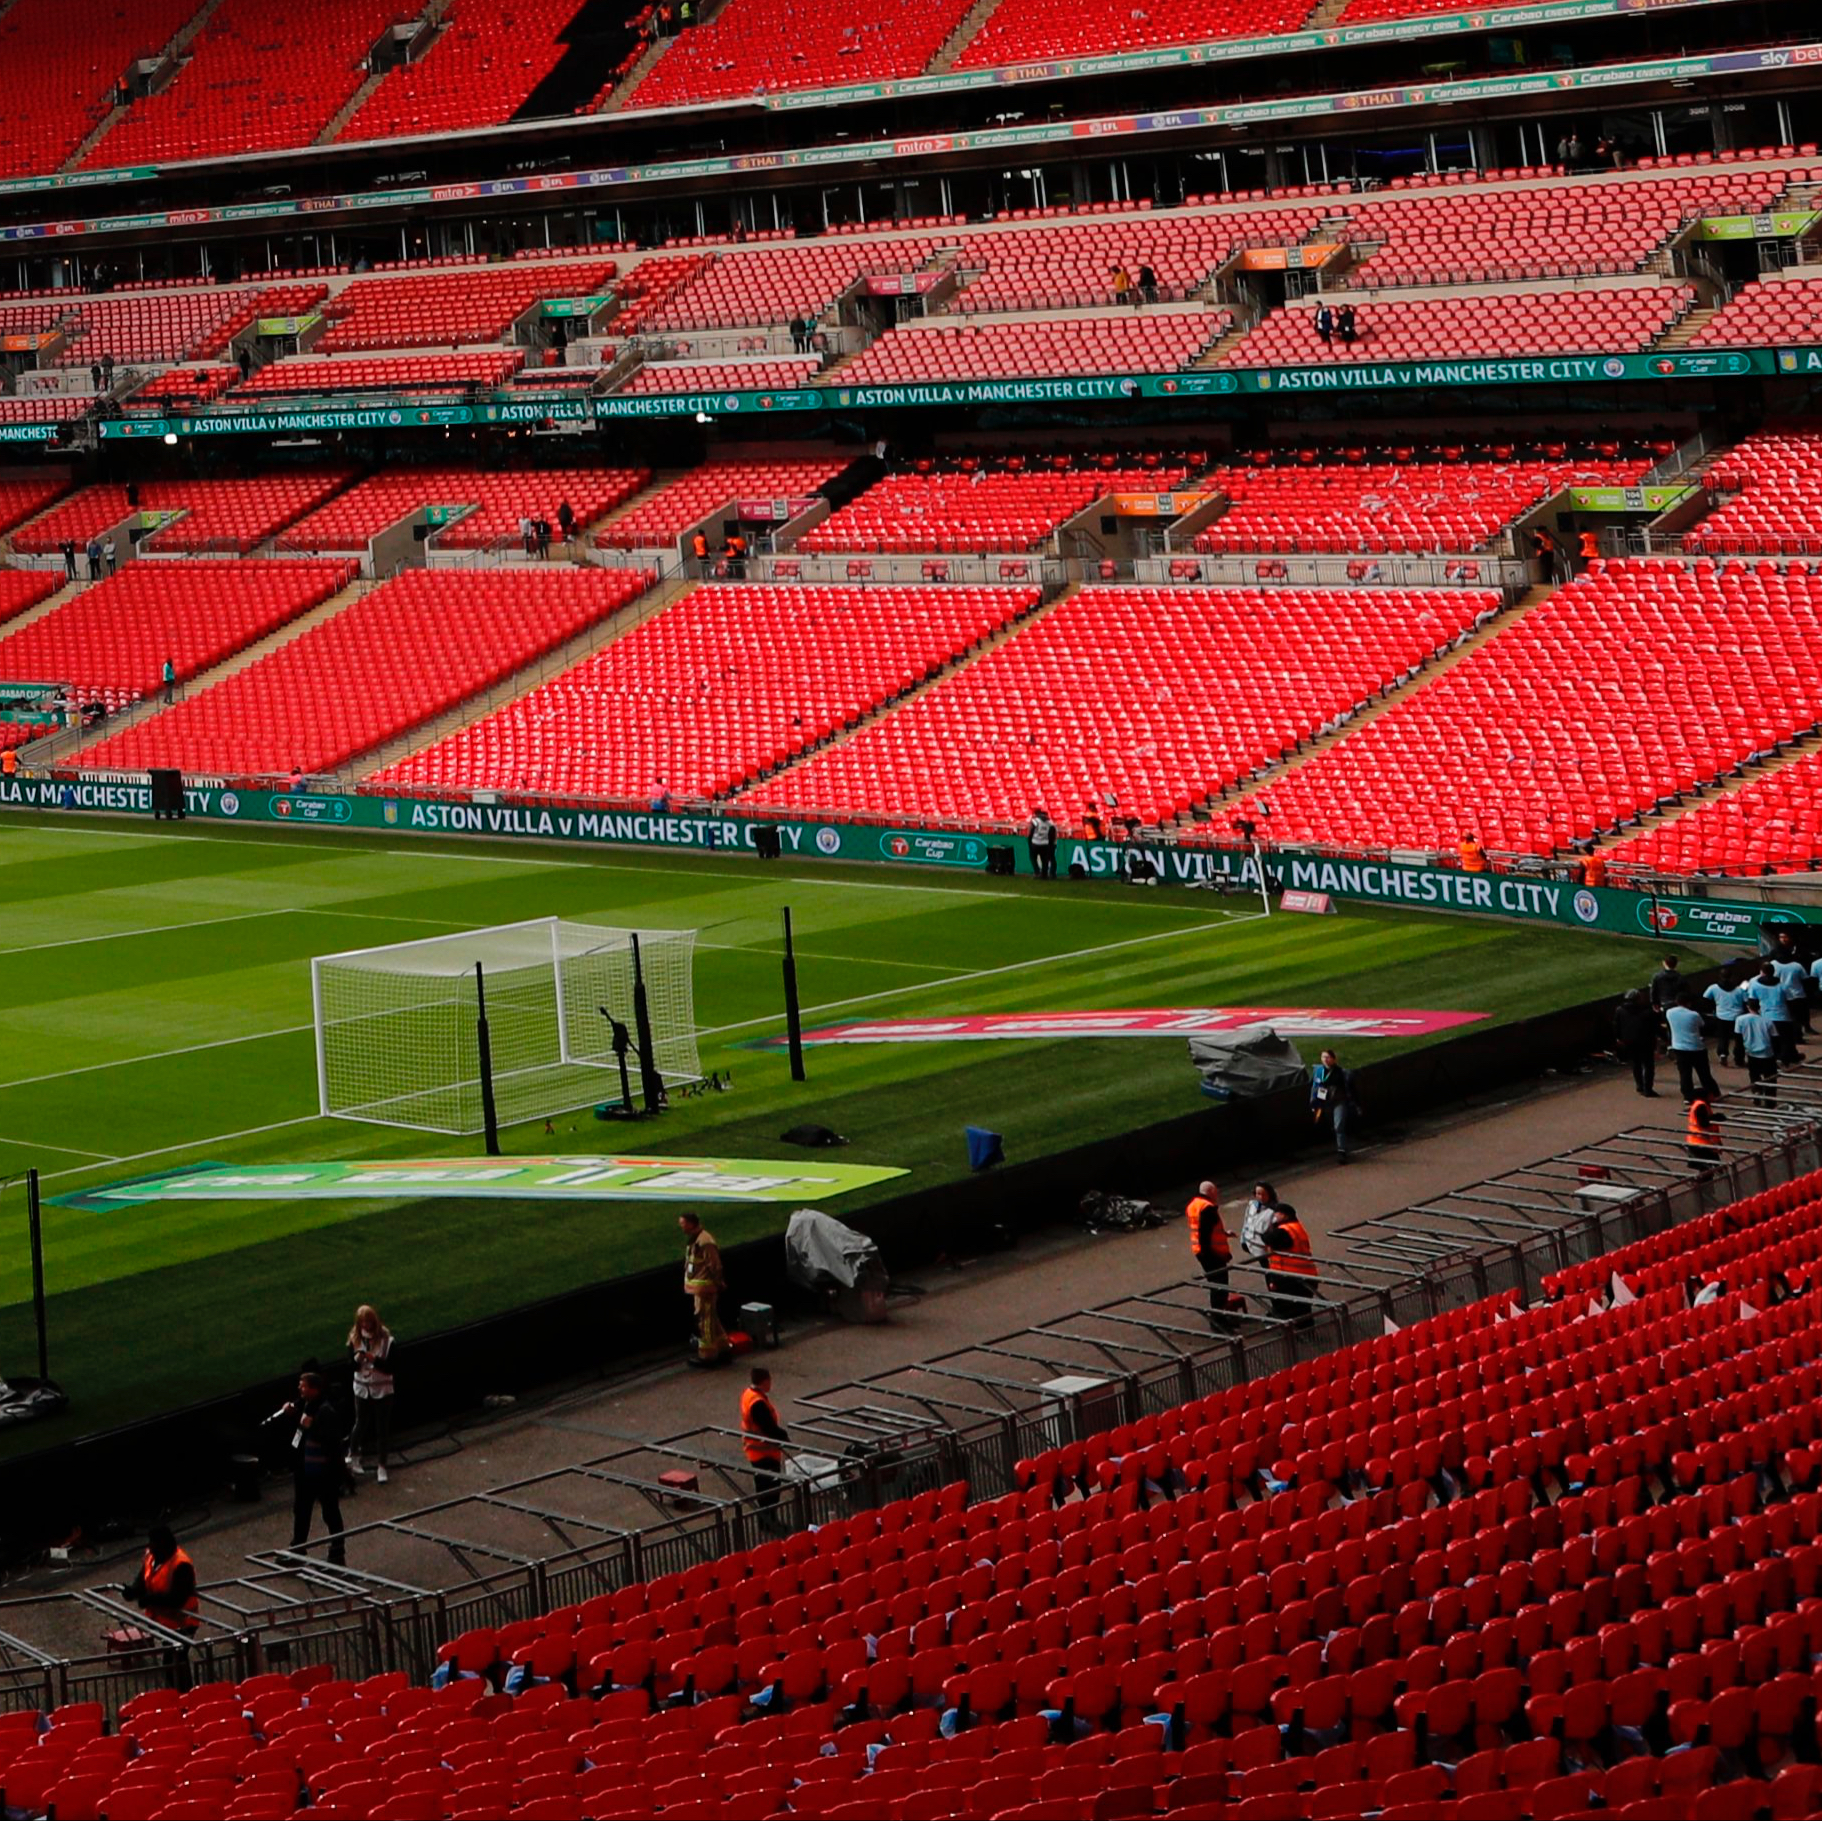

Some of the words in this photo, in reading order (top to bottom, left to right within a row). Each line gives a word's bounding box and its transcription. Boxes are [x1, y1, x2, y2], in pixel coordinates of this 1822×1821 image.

[1491, 9, 1543, 24] Carabao
[1545, 6, 1583, 19] ENERGY
[1585, 2, 1614, 14] DRINK
[1346, 27, 1393, 41] Carabao
[1760, 50, 1789, 66] sky
[1792, 46, 1822, 61] bet
[1018, 67, 1048, 78] THAI
[1581, 70, 1634, 85] Carabao
[1636, 66, 1675, 79] ENERGY
[1677, 63, 1706, 76] DRINK
[1431, 84, 1480, 99] Carabao
[1482, 81, 1518, 94] ENERGY
[1520, 79, 1548, 91] DRINK
[1361, 93, 1394, 106] THAI
[1103, 122, 1118, 131] EFL
[1166, 115, 1182, 125] EFL
[897, 141, 932, 154] mitre
[1679, 358, 1718, 367] Carabao
[1690, 365, 1709, 374] Cup
[1279, 371, 1337, 387] ASTON
[1341, 369, 1395, 385] VILLA
[1400, 372, 1410, 382] v
[1416, 363, 1543, 382] MANCHESTER
[1551, 362, 1595, 377] CITY
[857, 390, 904, 403] ASTON
[908, 388, 952, 401] VILLA
[956, 390, 964, 400] v
[969, 383, 1072, 399] MANCHESTER
[1078, 381, 1113, 396] CITY
[502, 406, 543, 418] ASTON
[548, 403, 584, 416] VILLA
[597, 396, 685, 415] MANCHESTER
[688, 397, 721, 411] CITY
[195, 419, 231, 431] ASTON
[233, 418, 266, 429] VILLA
[269, 420, 275, 428] v
[278, 414, 354, 428] MANCHESTER
[358, 413, 385, 424] CITY
[26, 689, 41, 699] CUP
[26, 787, 36, 801] v
[41, 782, 153, 809] MANCHESTE
[296, 800, 326, 810] Carabao
[304, 808, 318, 817] Cup
[411, 804, 482, 830] ASTON
[487, 808, 554, 834] VILLA
[559, 818, 572, 834] v
[578, 813, 738, 847] MANCHESTER
[744, 821, 802, 851] CTY
[915, 838, 954, 850] Carabao
[926, 847, 945, 859] Cup
[1071, 845, 1165, 878] ASTON
[1171, 850, 1261, 884] VILLA
[1291, 860, 1492, 908] MANCHESTER
[1499, 881, 1560, 916] CITY
[1689, 907, 1751, 923] Carabao
[1706, 921, 1735, 935] Cup
